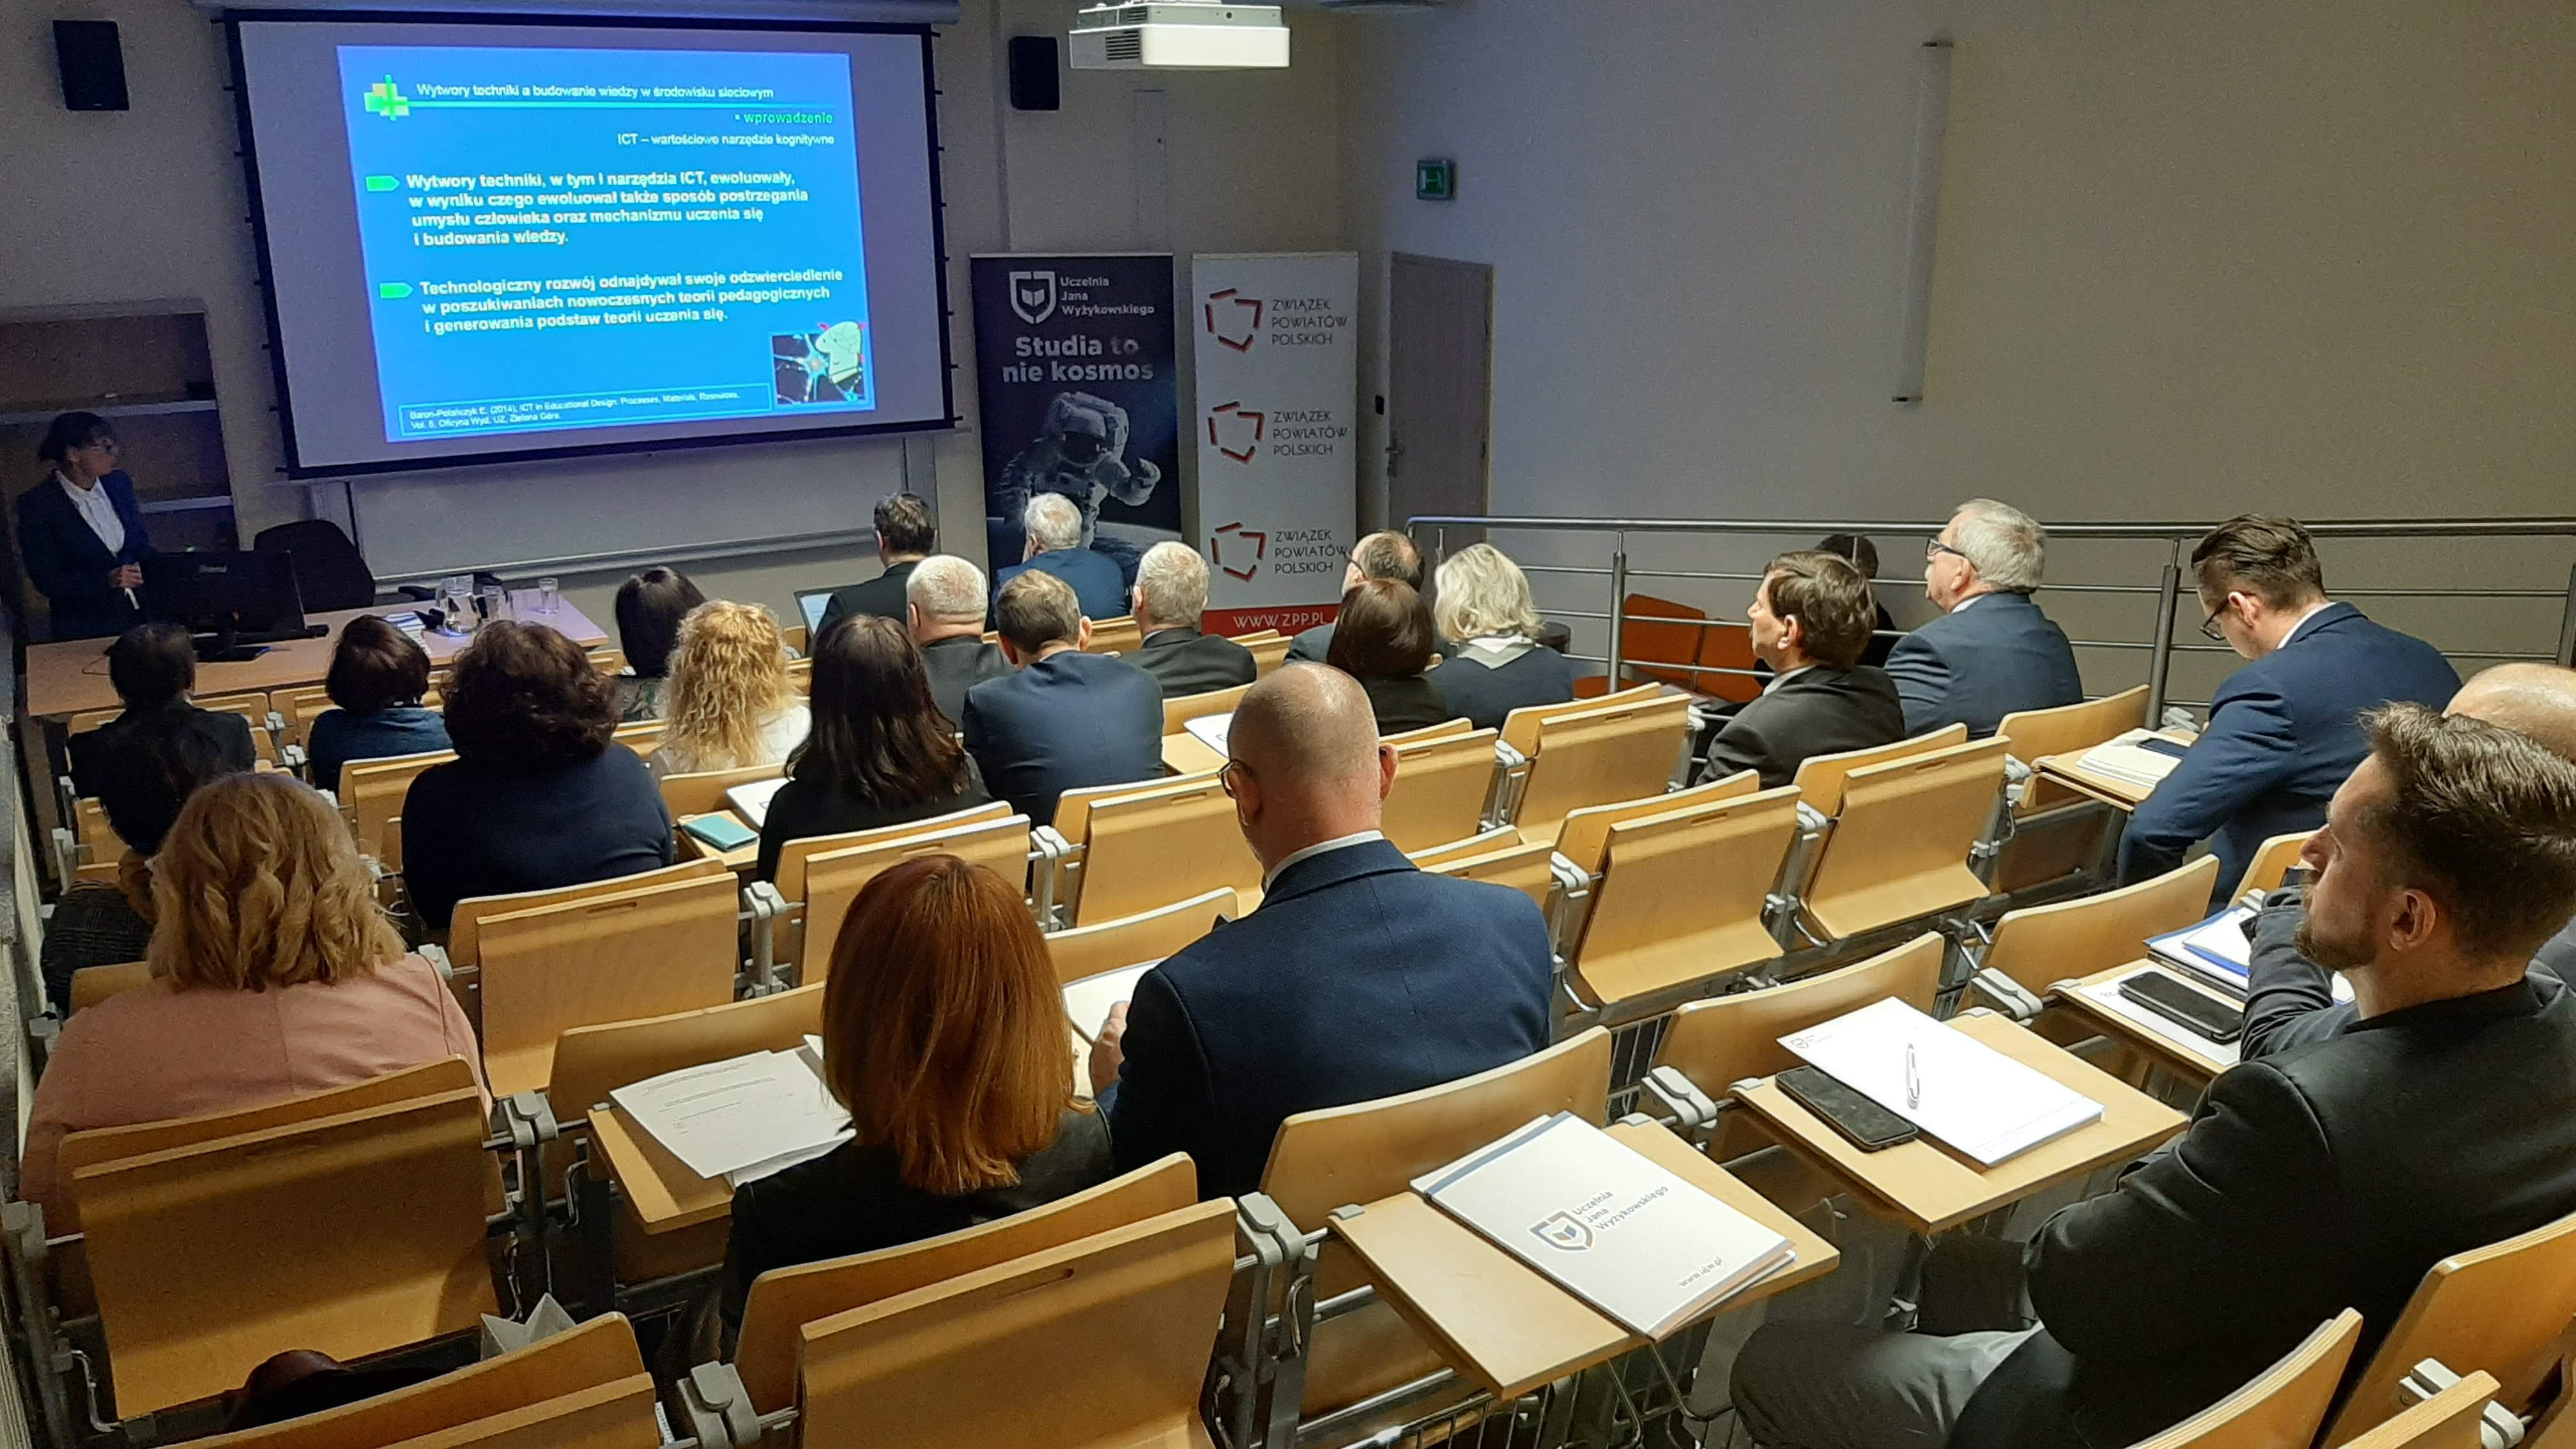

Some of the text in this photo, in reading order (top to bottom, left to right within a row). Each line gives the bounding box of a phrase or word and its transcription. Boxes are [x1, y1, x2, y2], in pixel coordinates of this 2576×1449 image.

[417, 84, 774, 100] Wytwory techniki a budowanie wiedzy w środowisku sieciowym
[744, 112, 833, 124] wprowadzenie
[618, 133, 638, 145] ICT
[650, 134, 719, 146] wartościowe
[722, 133, 773, 146] narzędzie
[776, 133, 834, 147] kognitywne
[406, 174, 475, 191] Wytwory
[480, 173, 546, 188] techniki,
[550, 176, 563, 186] w
[567, 173, 595, 188] tym
[608, 172, 677, 187] narzędzia
[680, 171, 707, 186] ICT,
[710, 171, 795, 187] ewoluowały,
[409, 188, 808, 210] w wyniku czego ewoluował także sposób postrzegania
[412, 206, 763, 229] umysłu człowieka oraz mechanizmu uczenia się
[423, 231, 510, 245] budowania
[513, 229, 569, 245] wiedzy.
[419, 269, 843, 295] Technologiczny rozwój odnajdywał swoje odzwierciedlenie
[1060, 277, 1109, 287] Uczelnia
[422, 286, 830, 316] w poszukiwaniach nowoczesnych teorii pedagogicznych
[1061, 291, 1088, 301] Jana
[1062, 304, 1155, 316] Wyżykowskiego
[1272, 298, 1331, 312] ZWIĄZEK
[434, 316, 533, 335] generowania
[537, 314, 601, 330] podstaw
[604, 309, 641, 324] teorii
[645, 307, 700, 323] uczenia
[703, 306, 728, 321] się.
[1272, 315, 1348, 328] POWIATÓW
[1016, 334, 1140, 356] Studia to
[1272, 334, 1332, 346] POLSKICH
[1002, 360, 1154, 383] nie kosmos
[544, 399, 589, 410] Educational
[1273, 411, 1331, 424] ZWIĄZEK
[1273, 426, 1347, 440] POWIATÓW
[1273, 444, 1333, 456] POLSKICH
[1275, 530, 1331, 544] ZWIĄZEK
[1275, 544, 1347, 558] POWIATÓW
[1275, 562, 1333, 574] POLSKICH
[1233, 611, 1327, 629] WWW.ZPP.PL
[1572, 1192, 1613, 1215] Uczelnia
[1588, 1208, 1609, 1223] Jana
